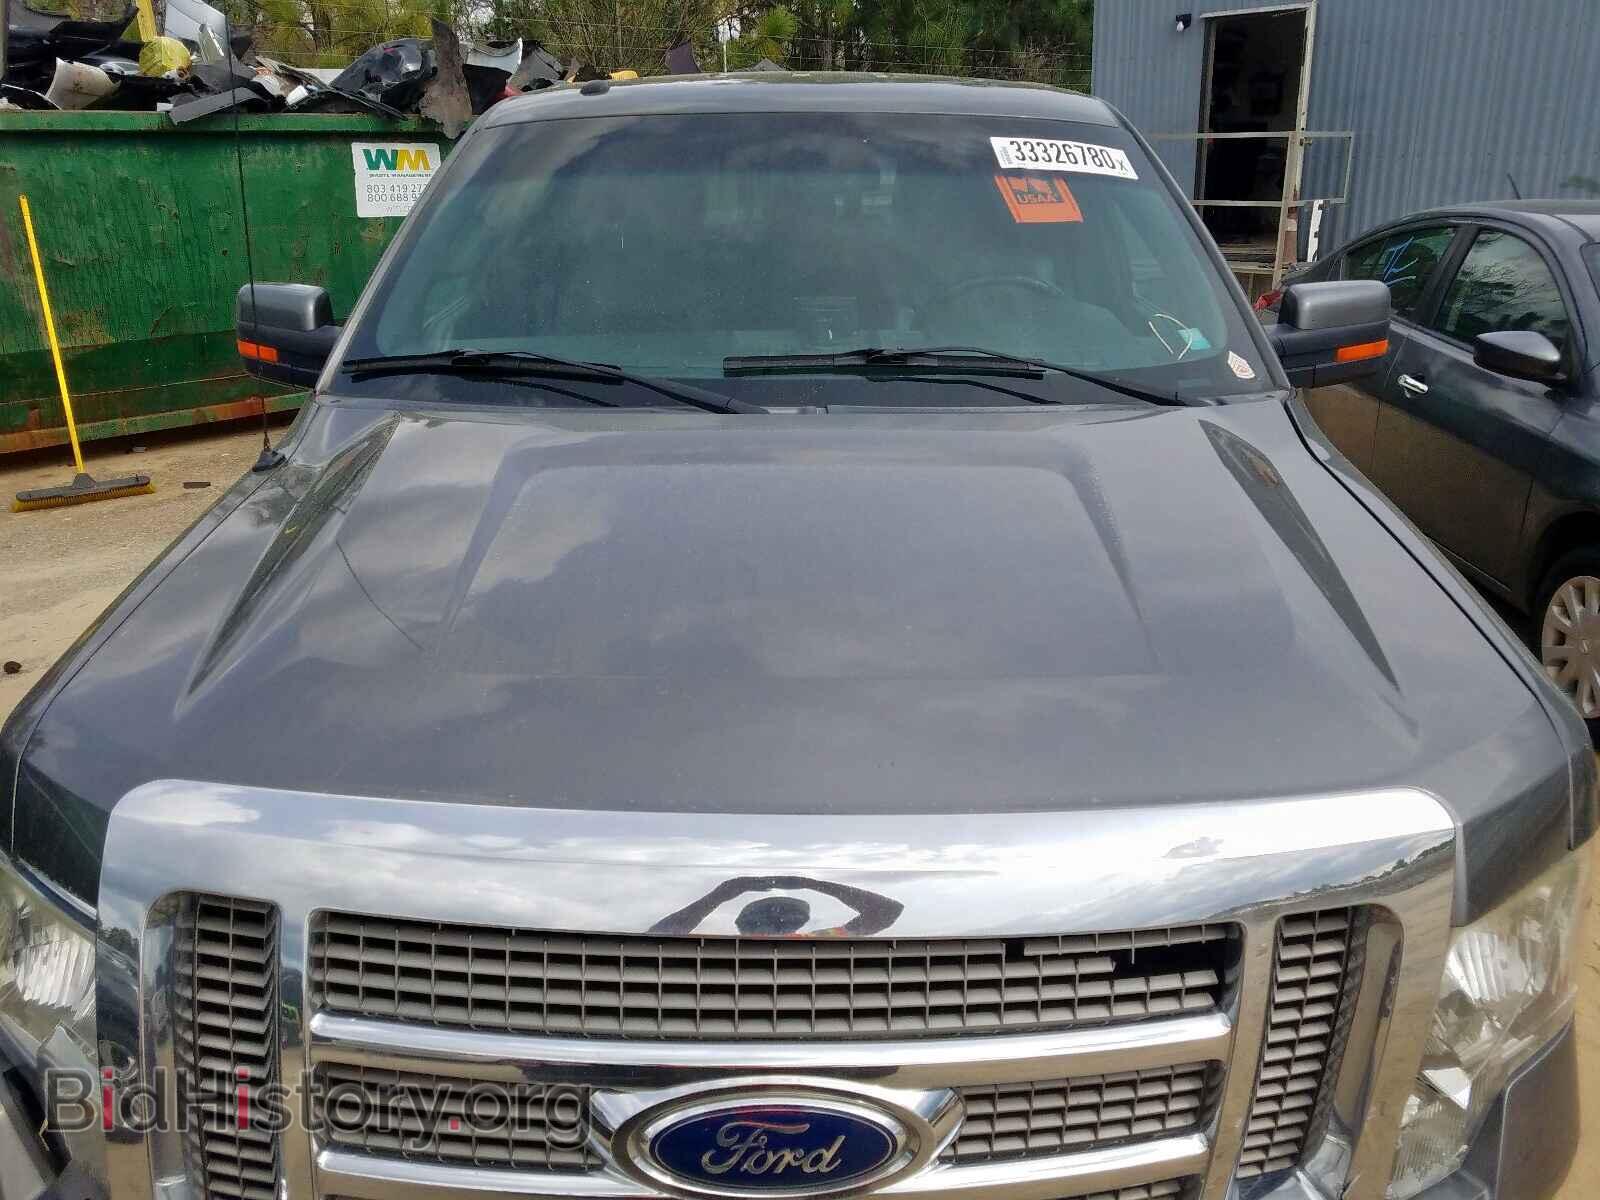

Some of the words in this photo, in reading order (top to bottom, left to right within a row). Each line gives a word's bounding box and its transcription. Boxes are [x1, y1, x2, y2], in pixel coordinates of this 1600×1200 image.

[362, 148, 431, 170] WM
[1010, 140, 1116, 169] 33326780
[366, 184, 386, 194] 803
[389, 184, 408, 194] 419
[367, 193, 387, 202] 800
[390, 193, 409, 202] 688
[1016, 193, 1057, 204] USAA
[701, 1121, 846, 1174] Ford
